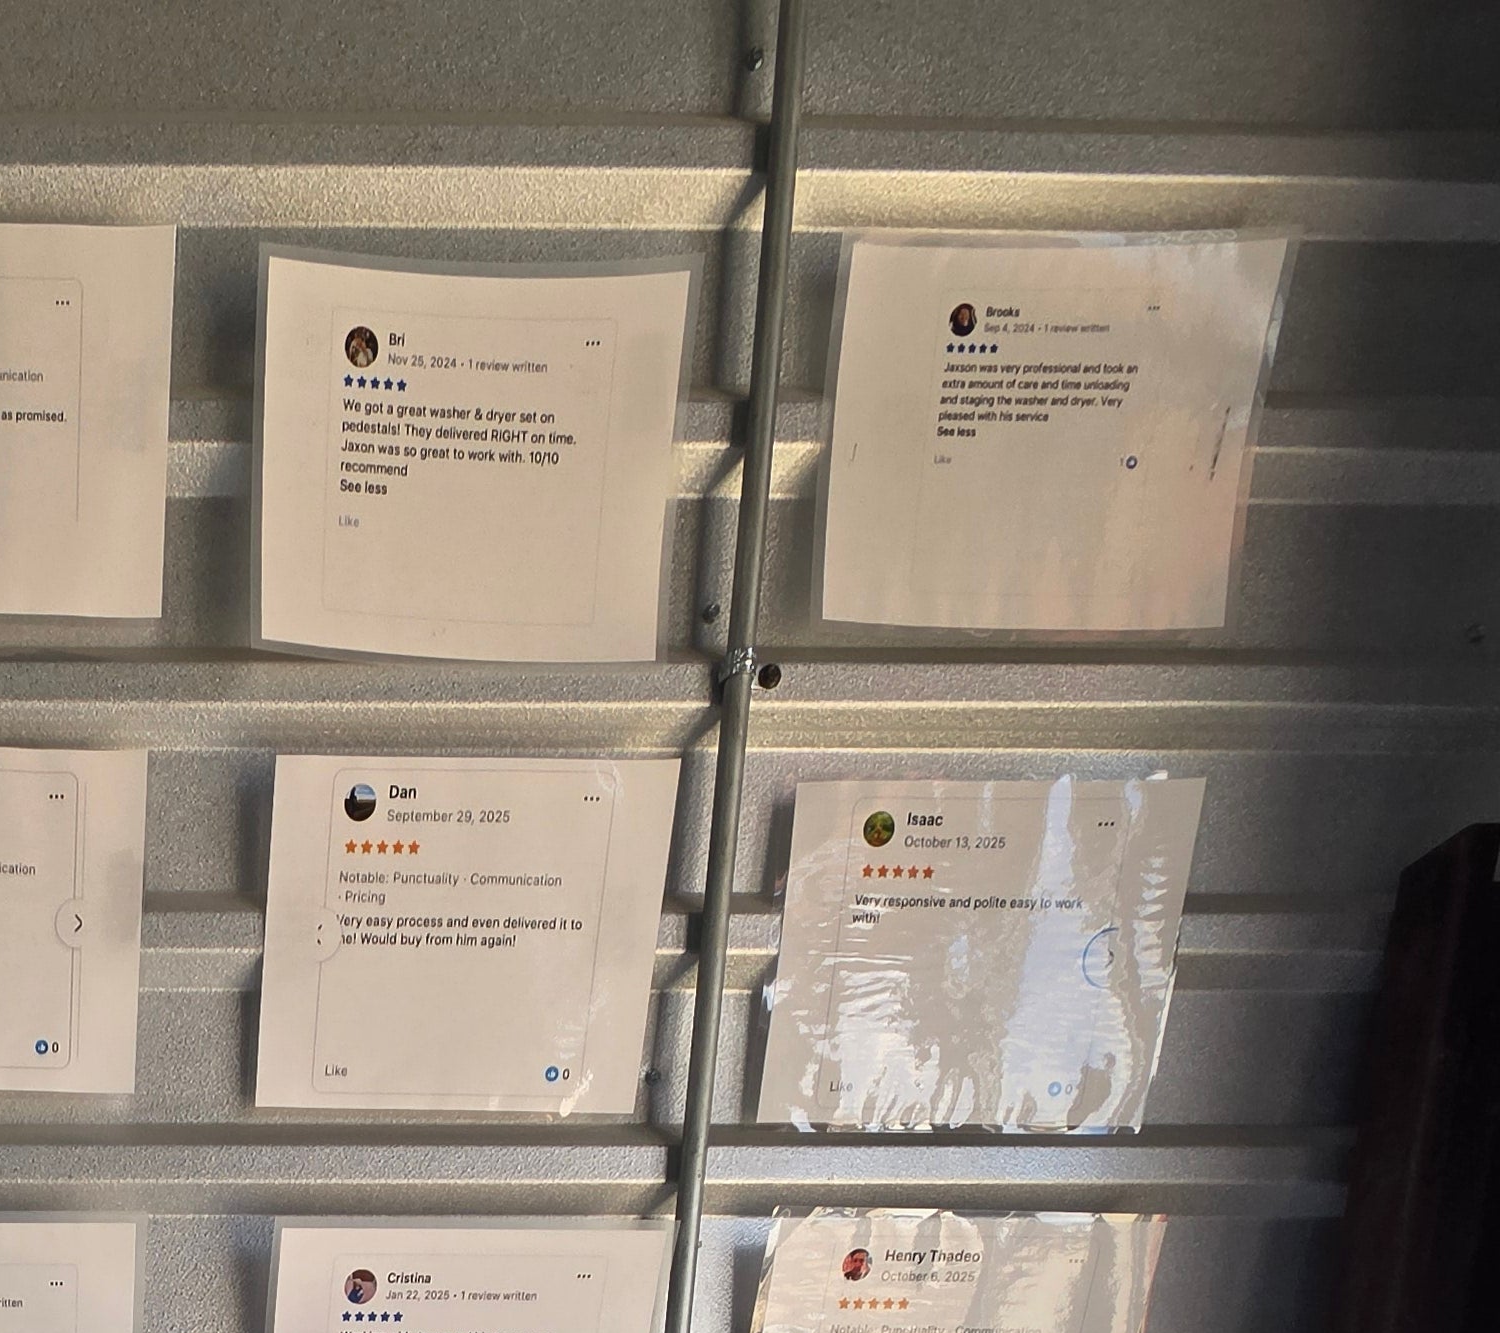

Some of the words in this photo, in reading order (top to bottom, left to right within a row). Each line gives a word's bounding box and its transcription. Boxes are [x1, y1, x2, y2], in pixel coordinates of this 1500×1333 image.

[986, 307, 1020, 317] Brooks
[389, 333, 404, 346] Bri
[388, 353, 408, 365] Nov
[431, 356, 456, 368] 2024
[469, 359, 472, 369] 1
[476, 360, 509, 371] review
[512, 361, 547, 372] written
[1, 411, 12, 420] as
[16, 410, 66, 423] promised.
[405, 424, 432, 440] They
[436, 426, 487, 441] delivered
[491, 429, 528, 442] RIGHT
[531, 434, 545, 443] on
[390, 785, 416, 799] Dan
[388, 809, 453, 823] September
[457, 810, 474, 825] 29,
[480, 810, 509, 823] 2025
[907, 812, 943, 826] Isaac
[905, 836, 952, 848] October
[975, 837, 1005, 849] 2025
[854, 895, 882, 909] Very
[884, 896, 945, 909] responsive
[949, 897, 971, 908] and
[973, 896, 1006, 910] polite
[1010, 899, 1037, 911] easy
[1054, 897, 1083, 910] work
[366, 917, 392, 929] easy
[397, 917, 442, 928] process
[447, 916, 468, 927] and
[472, 919, 499, 928] even
[503, 917, 556, 929] delivered
[560, 918, 566, 930] it
[571, 920, 582, 930] to
[52, 1042, 58, 1053] 0
[325, 1065, 347, 1076] Like
[563, 1069, 569, 1080] 0
[884, 1250, 926, 1265] Henry
[930, 1250, 981, 1263] Thadeo
[388, 1272, 431, 1283] Cristina
[881, 1271, 929, 1283] October
[945, 1271, 975, 1282] 2025
